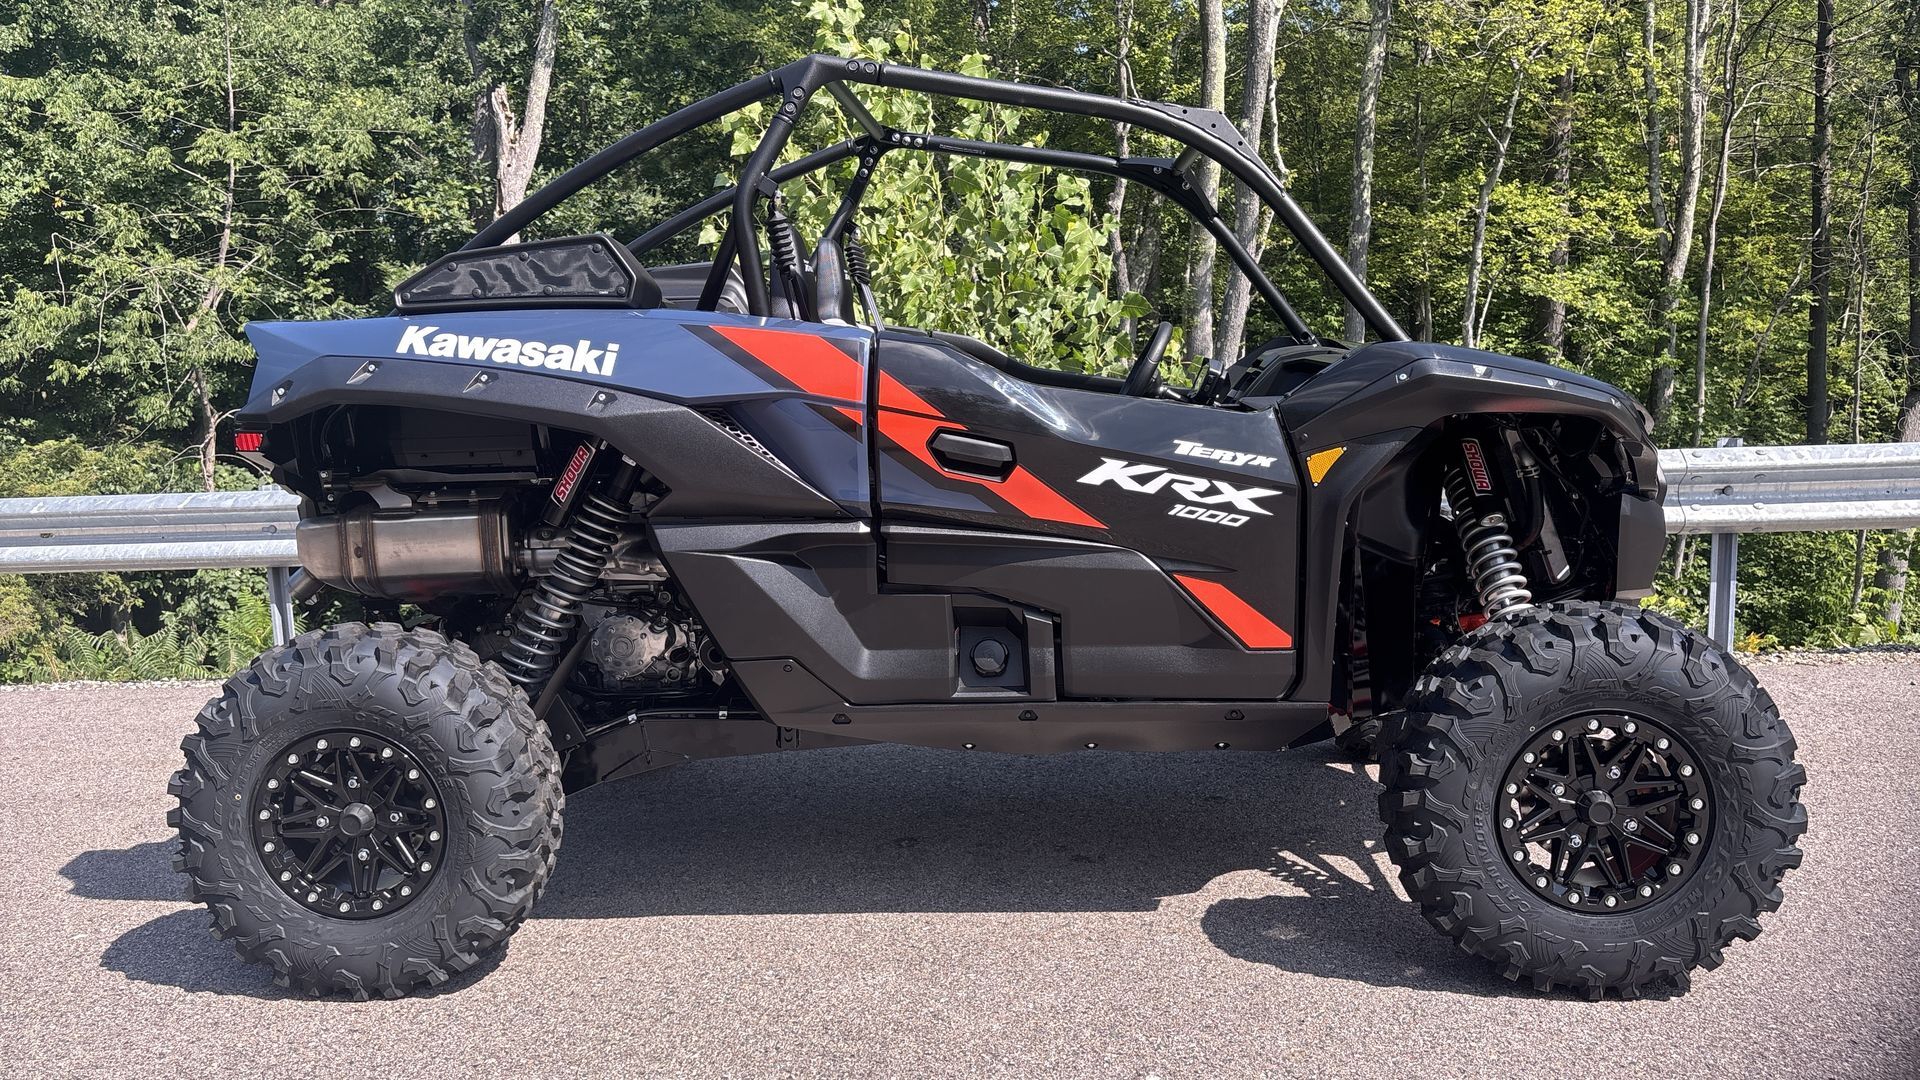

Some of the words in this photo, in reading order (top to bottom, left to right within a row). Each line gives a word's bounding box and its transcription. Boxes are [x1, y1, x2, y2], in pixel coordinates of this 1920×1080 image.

[396, 325, 620, 377] Kawasaki
[555, 445, 590, 503] SHOWA
[1076, 457, 1283, 516] KRX
[1462, 443, 1491, 490] SHOWA
[1167, 503, 1251, 527] 1000
[1474, 797, 1531, 913] CARNIVORE
